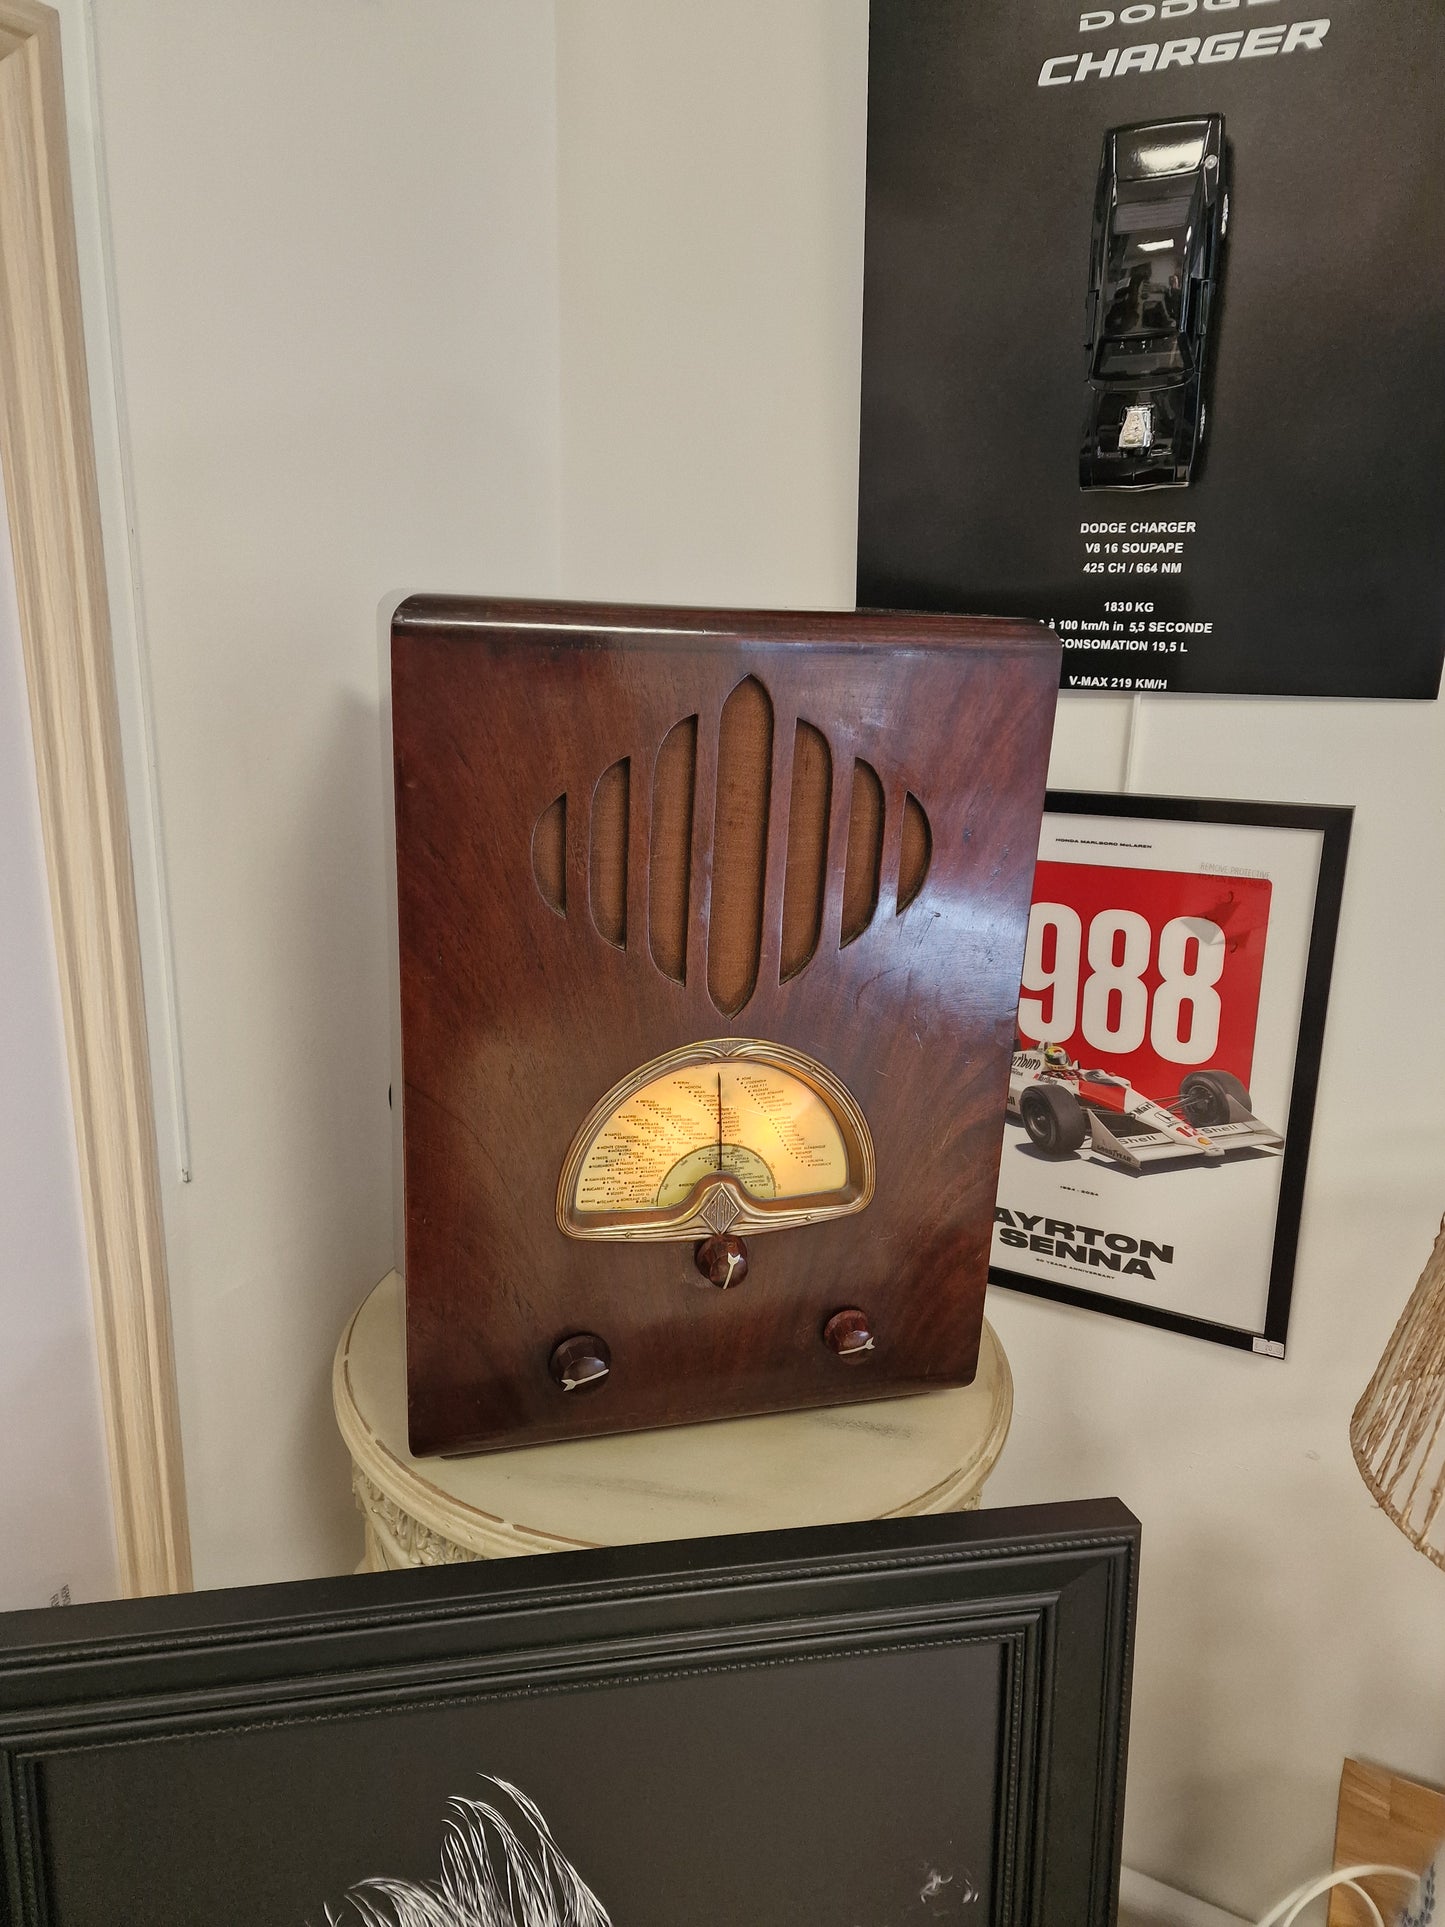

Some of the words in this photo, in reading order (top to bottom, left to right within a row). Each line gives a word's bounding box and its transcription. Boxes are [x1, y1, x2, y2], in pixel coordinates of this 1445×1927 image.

[1079, 0, 1282, 32] DODG
[1037, 18, 1331, 87] CHARGER
[1080, 522, 1127, 534] DODGE
[1130, 521, 1196, 533] CHARGER
[1085, 543, 1101, 553] V8
[1104, 543, 1119, 554] 16
[1121, 542, 1184, 553] SOUPAPE
[1083, 562, 1105, 573] 425
[1108, 562, 1126, 573] CH
[1136, 562, 1158, 573] 664
[1161, 562, 1182, 573] NM
[1104, 601, 1133, 612] 1830
[1135, 602, 1154, 613] KG
[1059, 619, 1078, 630] 100
[1081, 620, 1110, 631] km/h
[1112, 621, 1124, 631] in
[1129, 621, 1146, 634] 5,5
[1148, 622, 1213, 634] SECONDE
[1152, 641, 1177, 653] 19,5
[1180, 642, 1188, 652] L
[1069, 675, 1108, 687] V-MAX
[1110, 677, 1132, 688] 219
[1135, 678, 1168, 689] KM/H
[1080, 839, 1118, 847] MARLBORO
[1200, 862, 1228, 874] REMOVE
[1202, 1124, 1239, 1134] Shell
[1117, 1135, 1157, 1145] Shell
[994, 1206, 1174, 1264] AYRTON
[999, 1228, 1156, 1280] SENNA
[1069, 1266, 1115, 1280] ANNIVERSARY
